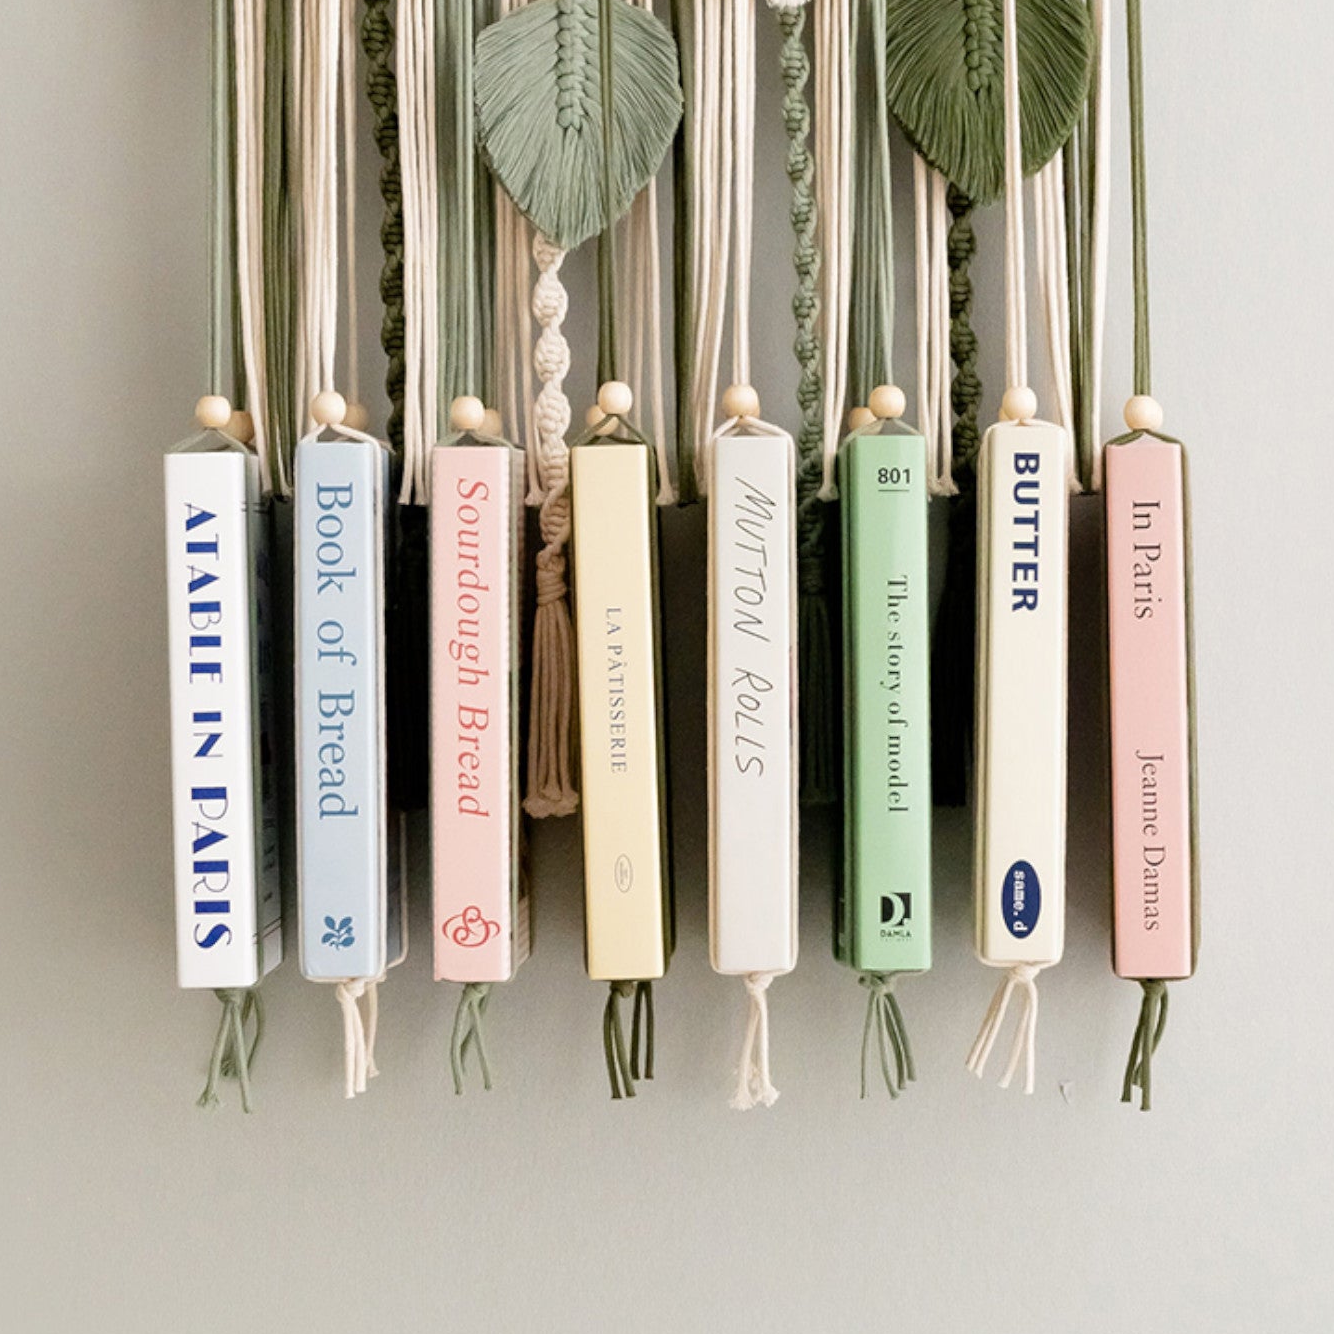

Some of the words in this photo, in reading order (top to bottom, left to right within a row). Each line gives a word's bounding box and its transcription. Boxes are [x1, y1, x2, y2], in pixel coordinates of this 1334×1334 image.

[877, 467, 910, 485] 801
[1132, 501, 1161, 531] In
[315, 482, 357, 595] Book
[732, 476, 777, 643] MUTTON
[1011, 452, 1041, 612] BUTTER
[448, 478, 490, 686] Sourdough
[606, 607, 622, 636] LA
[887, 575, 909, 623] The
[1133, 543, 1163, 620] Paris
[317, 620, 358, 667] of
[879, 632, 904, 691] story
[192, 711, 223, 758] IN
[607, 645, 628, 772] PÂTISSERIE
[731, 667, 774, 777] ROLLS
[887, 701, 908, 728] of
[318, 689, 359, 820] Bread
[457, 703, 491, 818] Bread
[887, 735, 909, 812] model
[1135, 749, 1165, 836] Jeanne
[190, 786, 231, 949] PARIS
[1143, 845, 1166, 931] Damas
